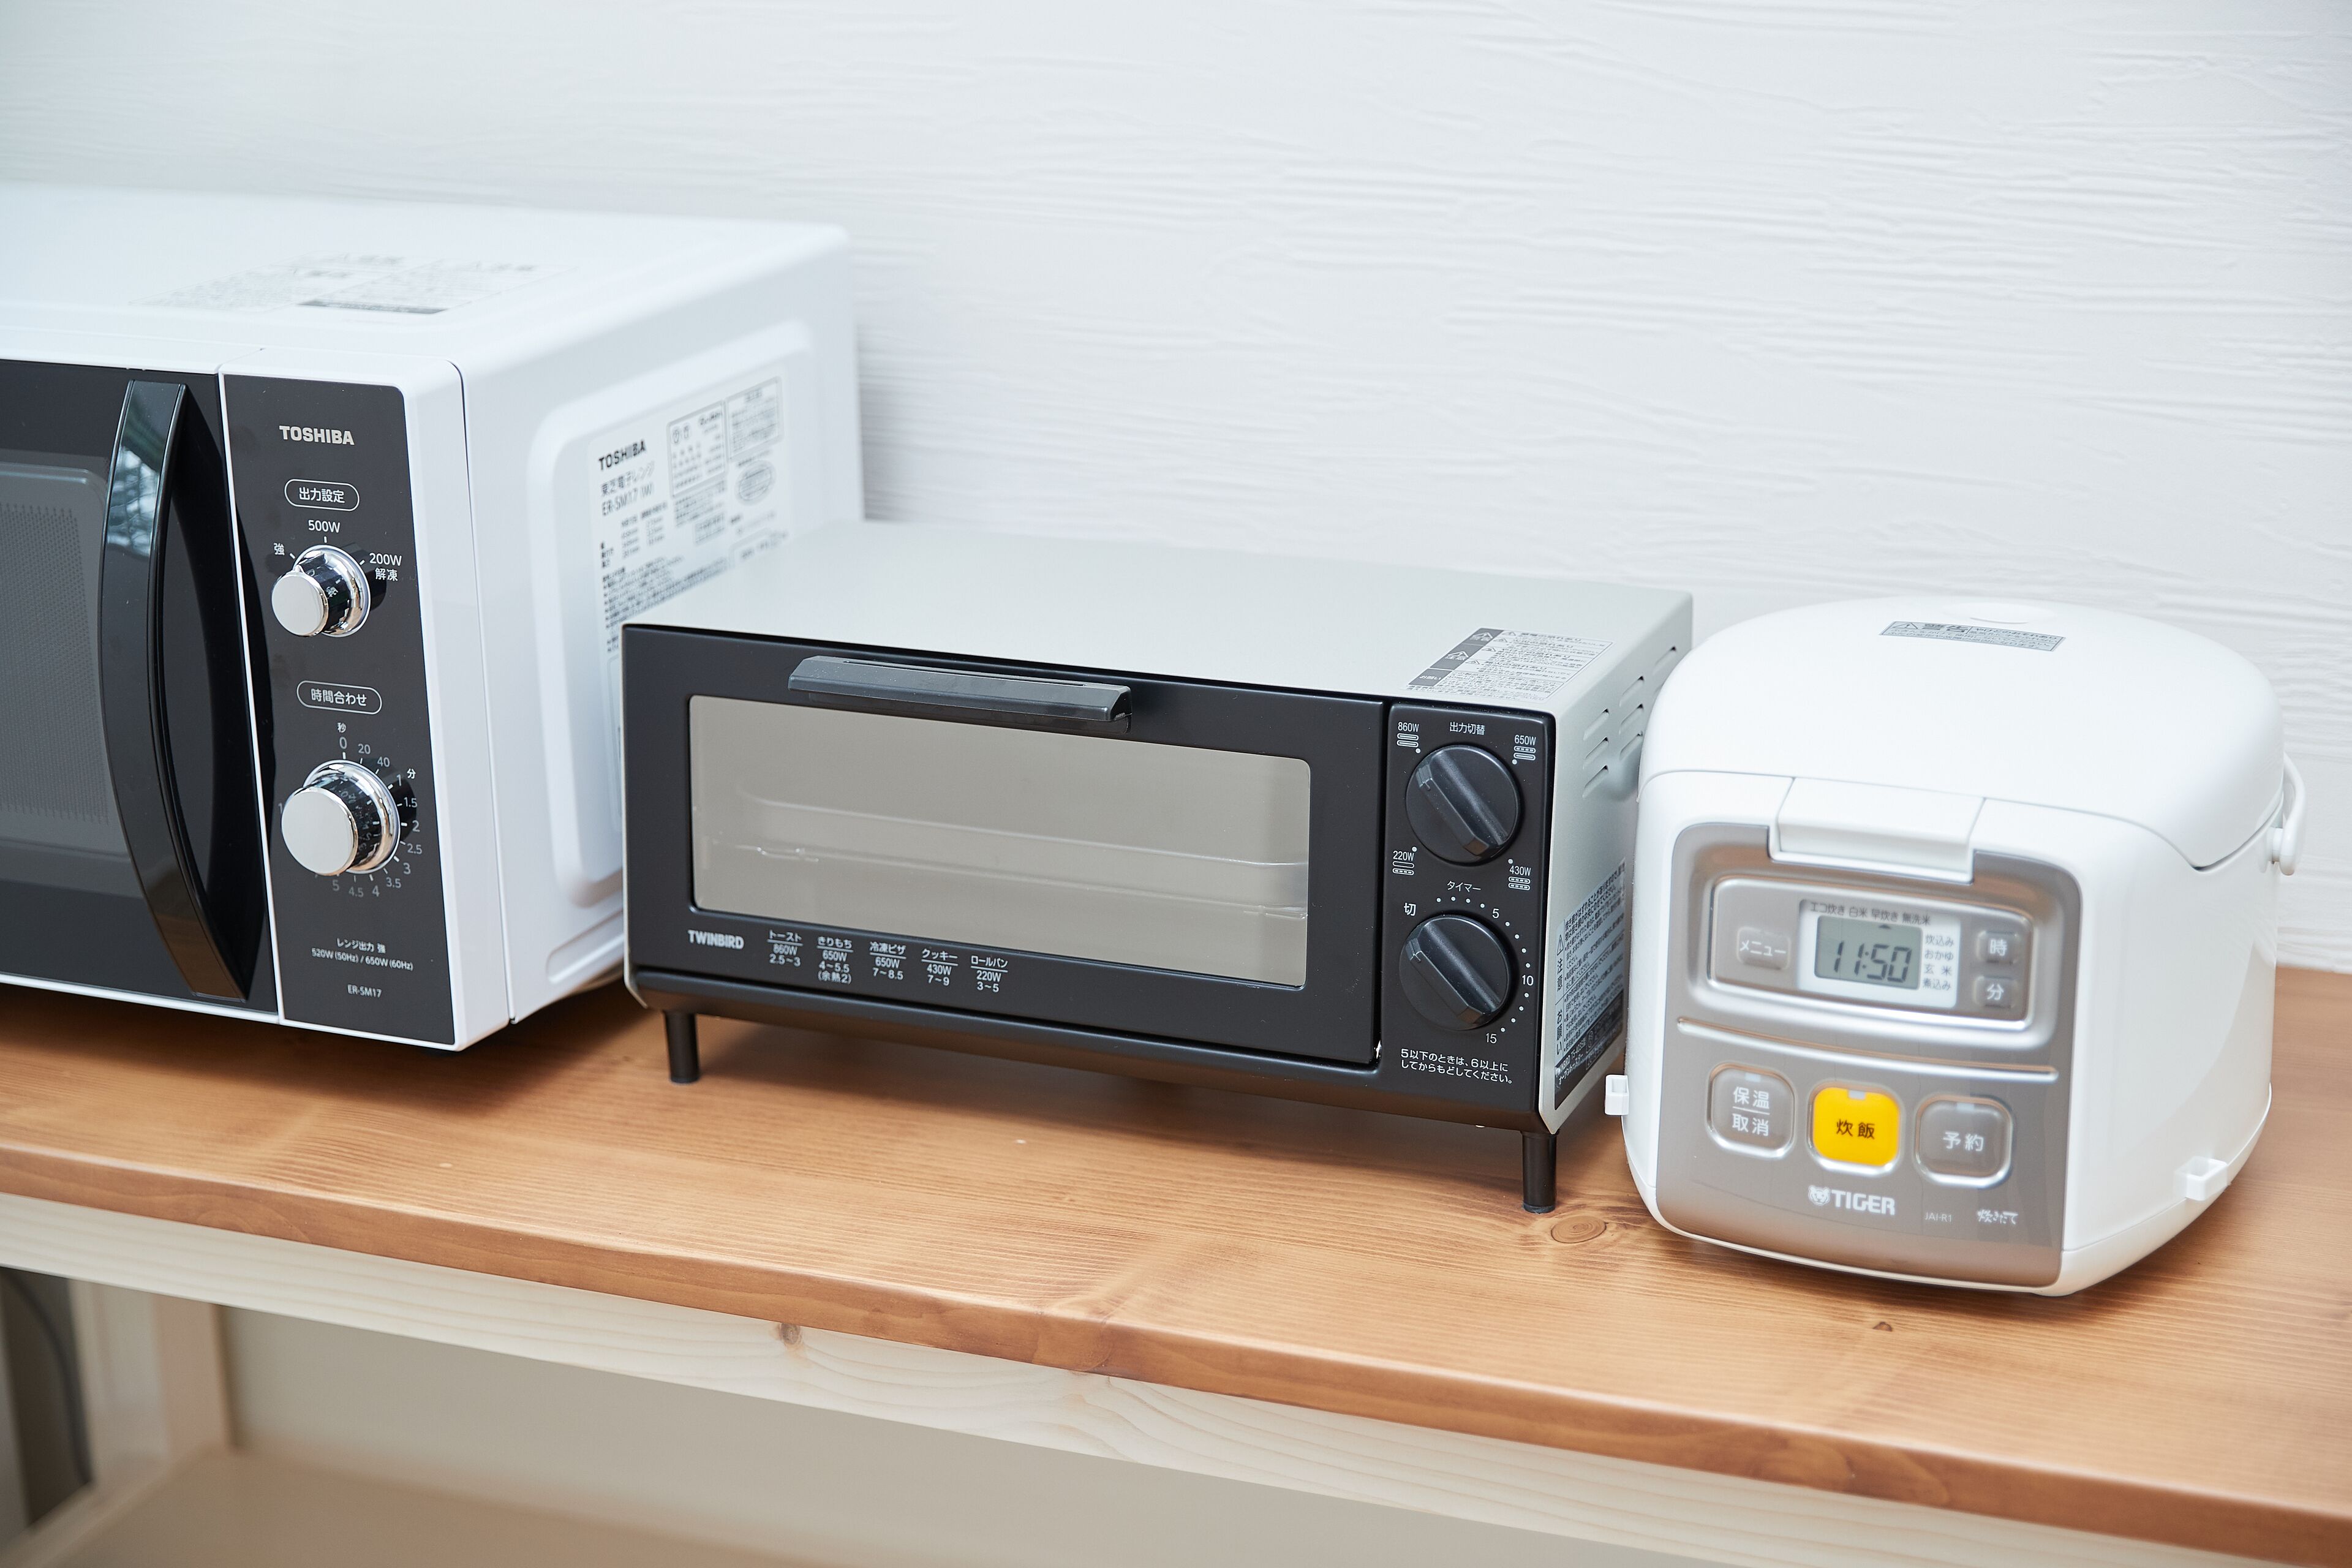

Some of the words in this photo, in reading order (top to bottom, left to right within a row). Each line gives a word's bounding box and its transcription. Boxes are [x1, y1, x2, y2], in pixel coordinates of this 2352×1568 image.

[279, 425, 355, 445] TOSHIBA
[299, 487, 345, 503] 出力設定
[308, 519, 341, 533] 500W
[274, 543, 285, 556] 強
[369, 553, 402, 566] 200W
[375, 568, 398, 581] 解凍
[311, 688, 367, 707] 時間合わせ
[337, 722, 346, 733] 秒
[1398, 722, 1419, 733] 860W
[1449, 722, 1485, 736] 出力切替
[339, 737, 347, 749] 0
[1514, 734, 1536, 746] 650W
[358, 744, 371, 755] 20
[377, 756, 390, 767] 40
[397, 774, 402, 786] 1
[407, 768, 416, 779] 分
[404, 797, 418, 808] 1.5
[412, 820, 420, 833] 2
[407, 843, 423, 854] 2.5
[1393, 850, 1414, 861] 220W
[403, 862, 411, 875] 3
[1509, 865, 1531, 876] 430W
[332, 880, 339, 892] 5
[386, 876, 401, 889] 3.5
[1447, 881, 1482, 893] タイマー
[349, 887, 364, 898] 4.5
[372, 886, 380, 897] 4
[1404, 902, 1417, 916] 切
[1492, 908, 1499, 919] 5
[1811, 902, 1845, 916] エコ炊き
[1849, 907, 1868, 918] 白米
[1871, 909, 1899, 922] 早炊き
[1902, 913, 1931, 926] 無洗米
[688, 930, 744, 949] TWINBIRD
[769, 929, 802, 942] トースト
[1925, 934, 1954, 947] 炊込み
[337, 938, 375, 952] レンジ出力
[817, 936, 853, 949] きりもち
[869, 941, 907, 956] 冷凍ピザ
[1739, 939, 1786, 957] メニュー
[1989, 939, 2008, 957] 時
[773, 944, 797, 956] 860W
[822, 950, 848, 962] 650W
[921, 948, 958, 961] クッキー
[1924, 949, 1954, 962] おかゆ
[311, 948, 334, 960] 520W
[334, 951, 359, 963] (50Hz)
[365, 956, 388, 967] 650W
[390, 959, 414, 971] (60Hz)
[875, 956, 900, 969] 650W
[971, 956, 1008, 968] ロールパン
[1834, 941, 1912, 983] 11:50
[927, 963, 952, 976] 430W
[976, 970, 1001, 982] 220W
[1522, 974, 1534, 986] 10
[1923, 980, 1951, 991] 煮込み
[347, 984, 382, 998] ER-SM17
[1987, 984, 2005, 1001] 分
[1485, 1033, 1497, 1044] 15
[1401, 1048, 1509, 1072] 5以下のときは、6以上に
[1401, 1059, 1513, 1084] してからもどしてください。
[1732, 1086, 1770, 1109] 保温
[1732, 1114, 1770, 1137] 取消
[1836, 1119, 1875, 1140] 炊飯
[1942, 1131, 1985, 1152] 予約
[1831, 1189, 1895, 1215] TIGER
[1924, 1211, 1953, 1223] JAI-R1
[1977, 1208, 2019, 1225] 炊きたて
